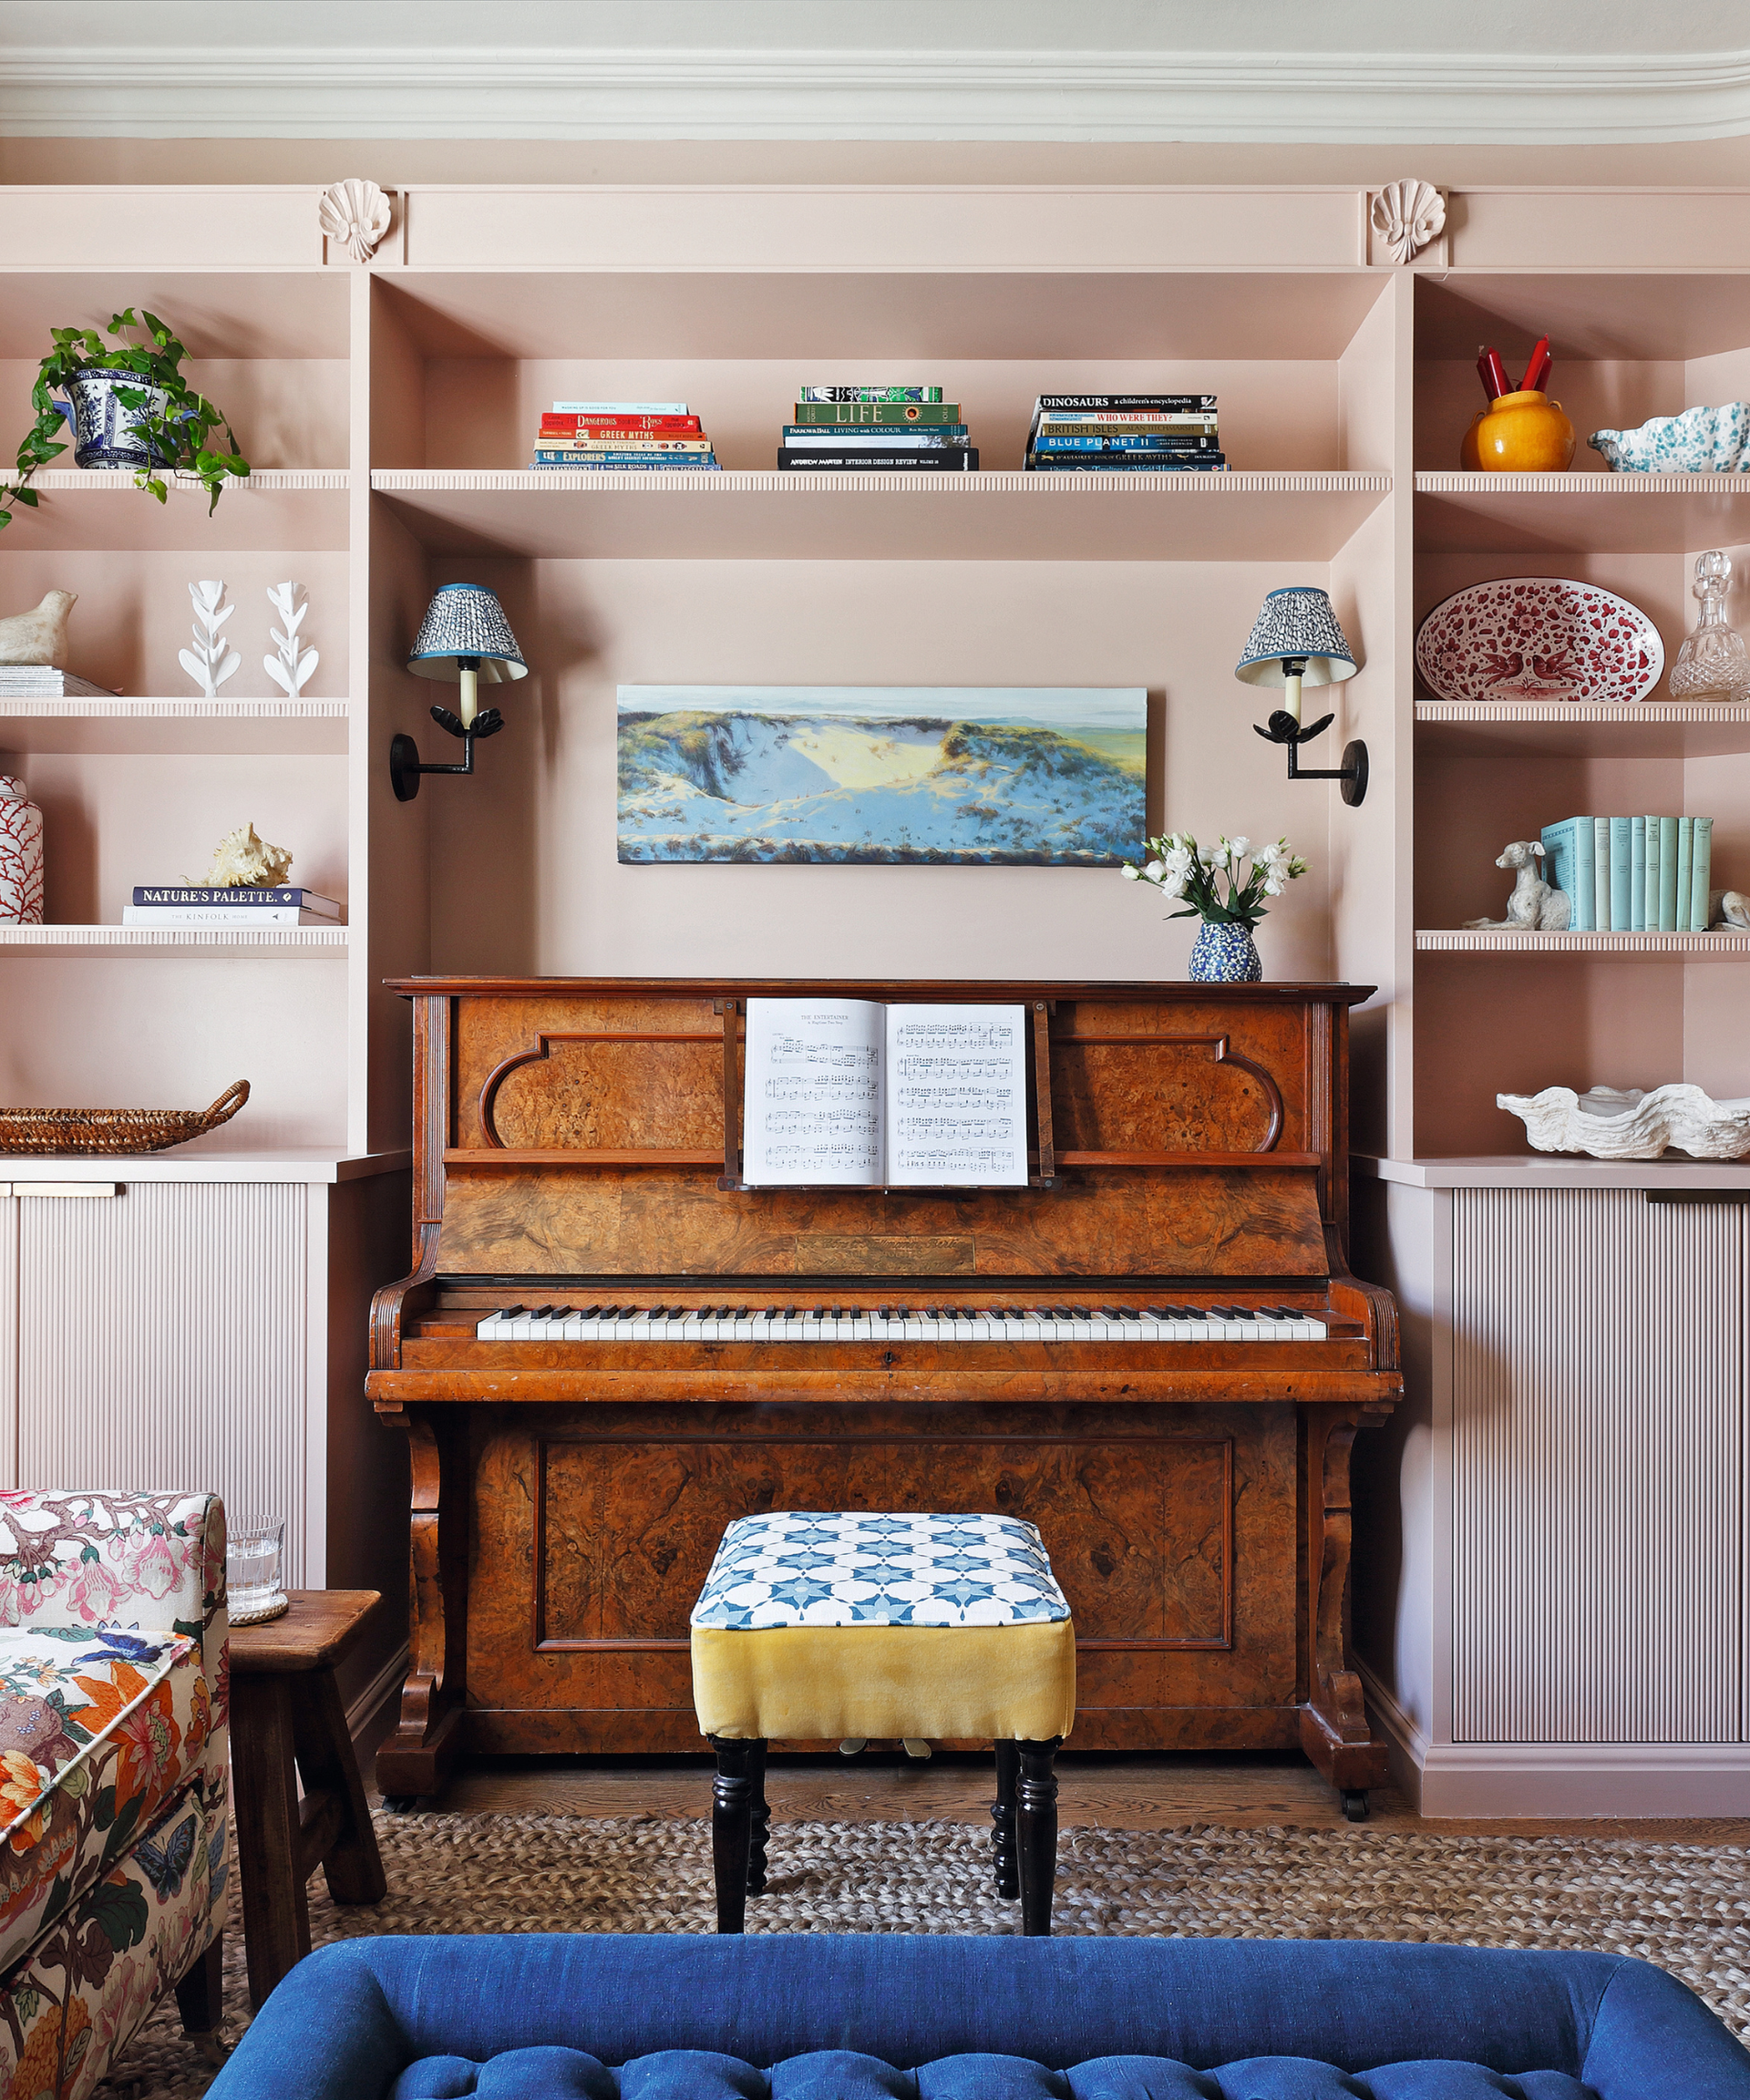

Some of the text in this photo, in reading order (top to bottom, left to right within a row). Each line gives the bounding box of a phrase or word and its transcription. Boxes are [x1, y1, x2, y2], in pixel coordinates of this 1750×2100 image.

[1043, 397, 1108, 407] DINOSAURS
[836, 405, 883, 423] LIFE
[1048, 424, 1088, 433] BRITISH
[1092, 424, 1118, 433] ISLES
[600, 430, 654, 439] GREEK MYTHS
[1048, 438, 1149, 446] BLUE PLANET II
[562, 451, 606, 461] EXPLORERS
[143, 890, 278, 902] NATURE'S PALETTE.
